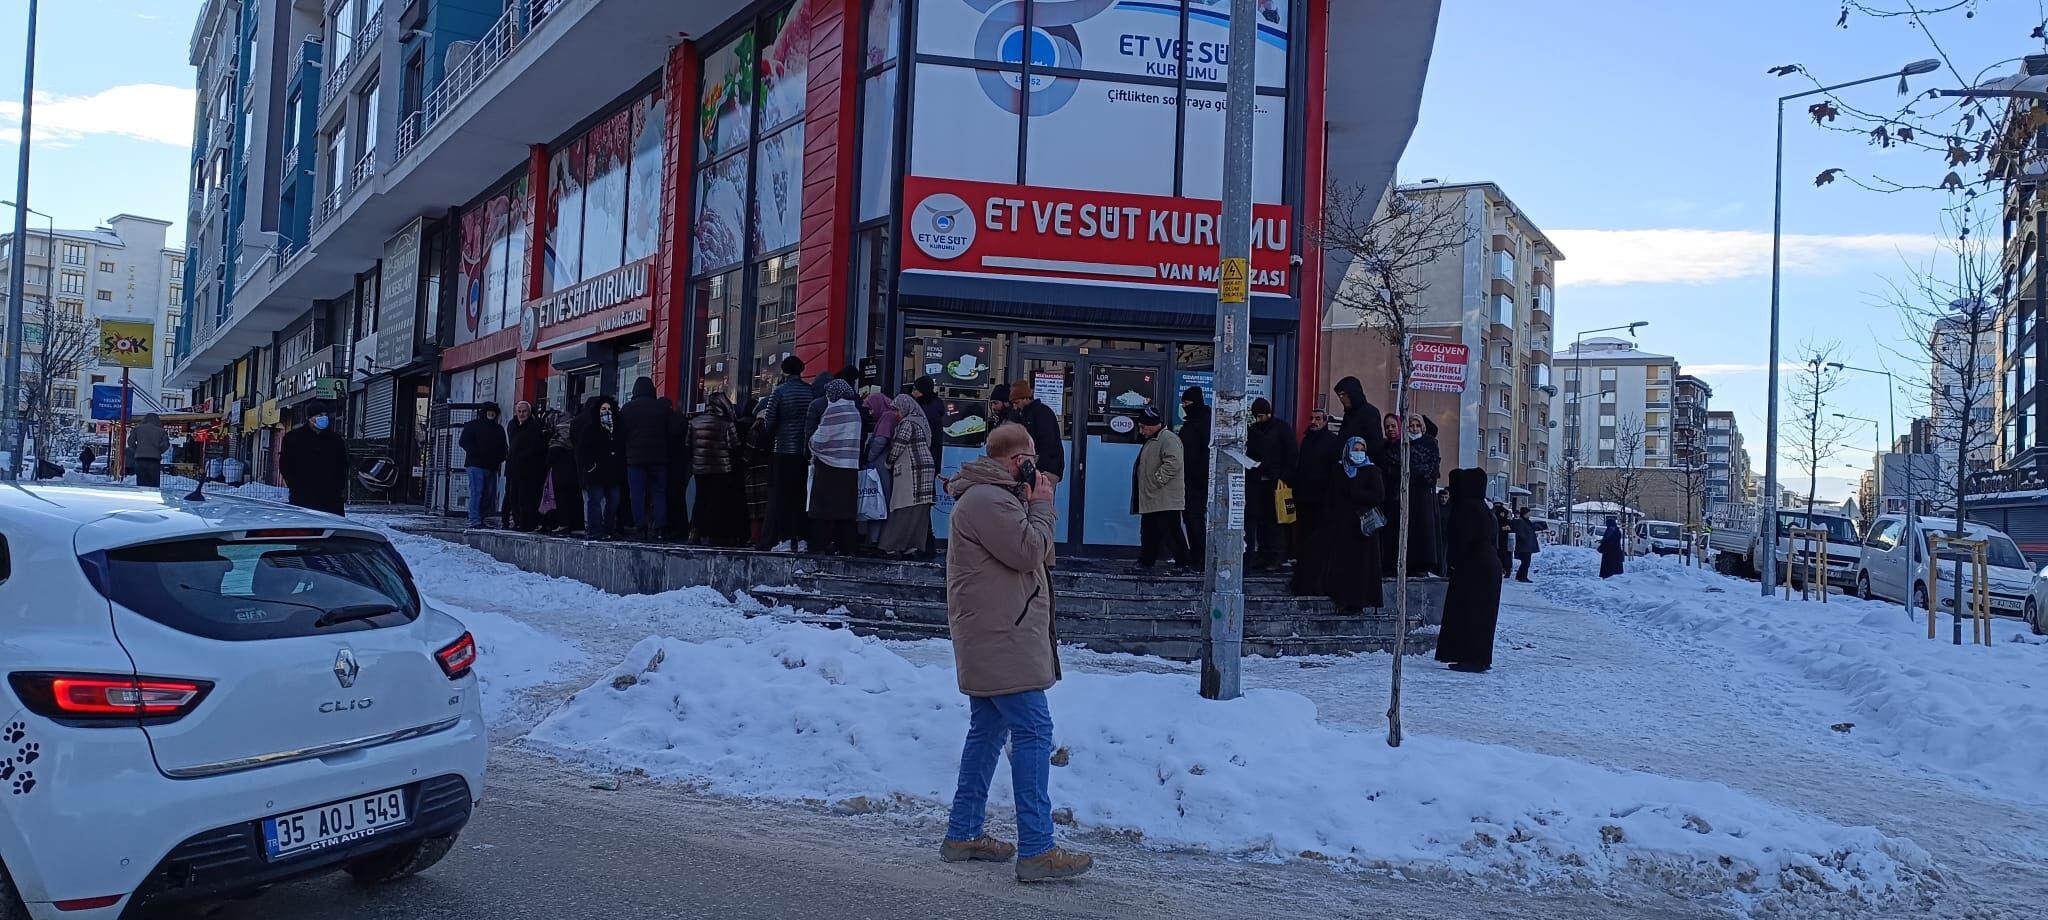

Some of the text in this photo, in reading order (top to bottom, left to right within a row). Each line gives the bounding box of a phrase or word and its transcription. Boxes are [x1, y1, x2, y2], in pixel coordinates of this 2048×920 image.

[1119, 34, 1150, 57] ET
[1198, 42, 1229, 66] SÜ
[1107, 89, 1159, 103] Çiftlikten
[985, 197, 1024, 232] ET
[1032, 200, 1074, 236] VE
[1079, 203, 1142, 240] SÜT
[918, 233, 968, 246] ET VE SÜT
[929, 243, 955, 251] KURUMU
[1159, 262, 1285, 287] VAN MAZASI
[539, 298, 552, 328] ET
[553, 293, 566, 324] VE
[566, 284, 589, 319] SÜT
[588, 263, 646, 312] KURUMU
[599, 307, 643, 332] VAN MAĞAZASI
[1415, 343, 1465, 356] ÖZGÜVEN
[1111, 420, 1132, 429] ÇIKIŞ
[318, 697, 374, 713] CLIO
[278, 793, 401, 847] 35 AOJ 549
[267, 838, 279, 848] TR
[310, 828, 375, 851] CTM AUTO
